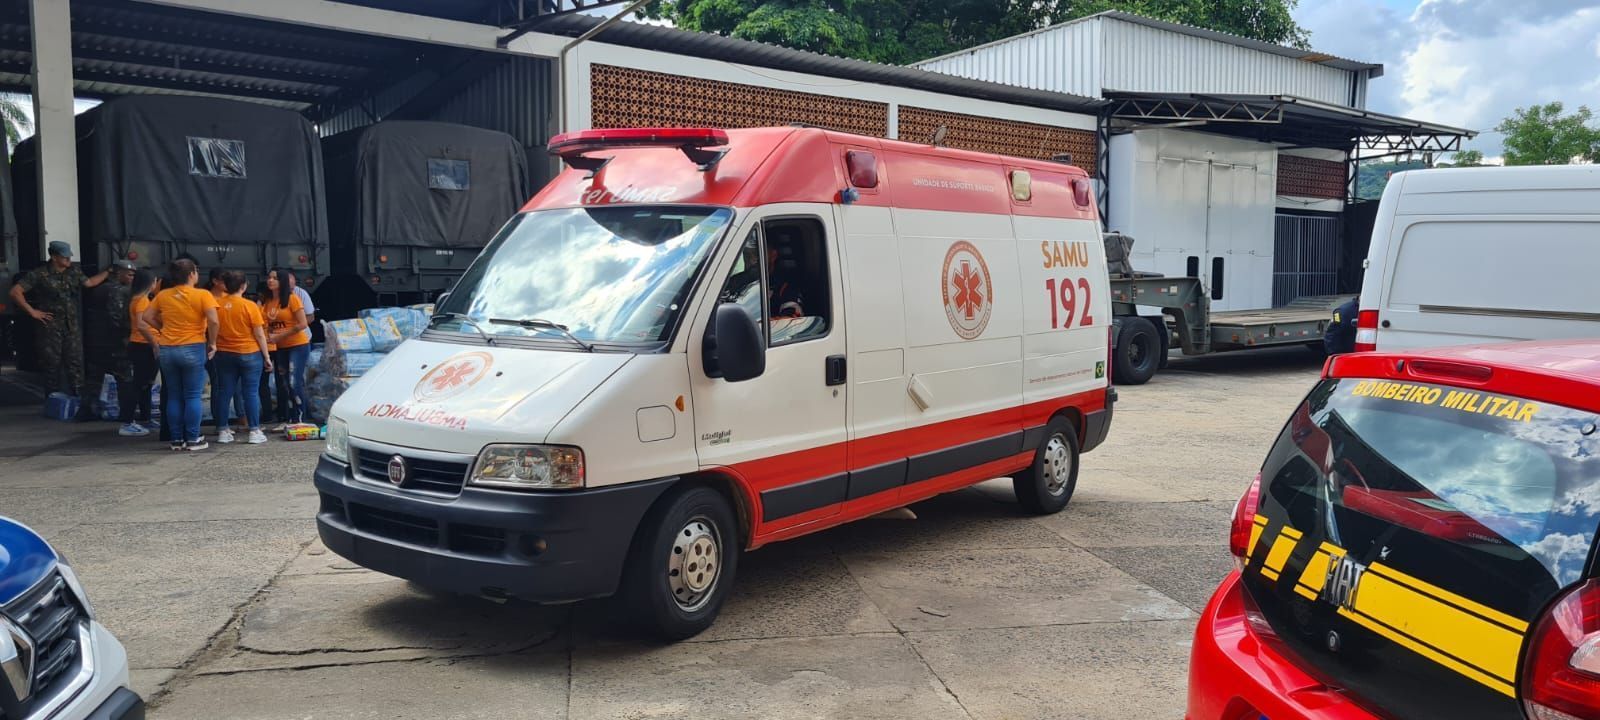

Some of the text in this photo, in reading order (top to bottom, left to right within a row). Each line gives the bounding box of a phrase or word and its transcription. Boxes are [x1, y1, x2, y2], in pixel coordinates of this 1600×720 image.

[1041, 240, 1089, 269] SAMU
[1045, 277, 1093, 329] 192
[1352, 380, 1540, 423] BOMBEIRO MILITAR
[1321, 553, 1367, 612] FIAT
